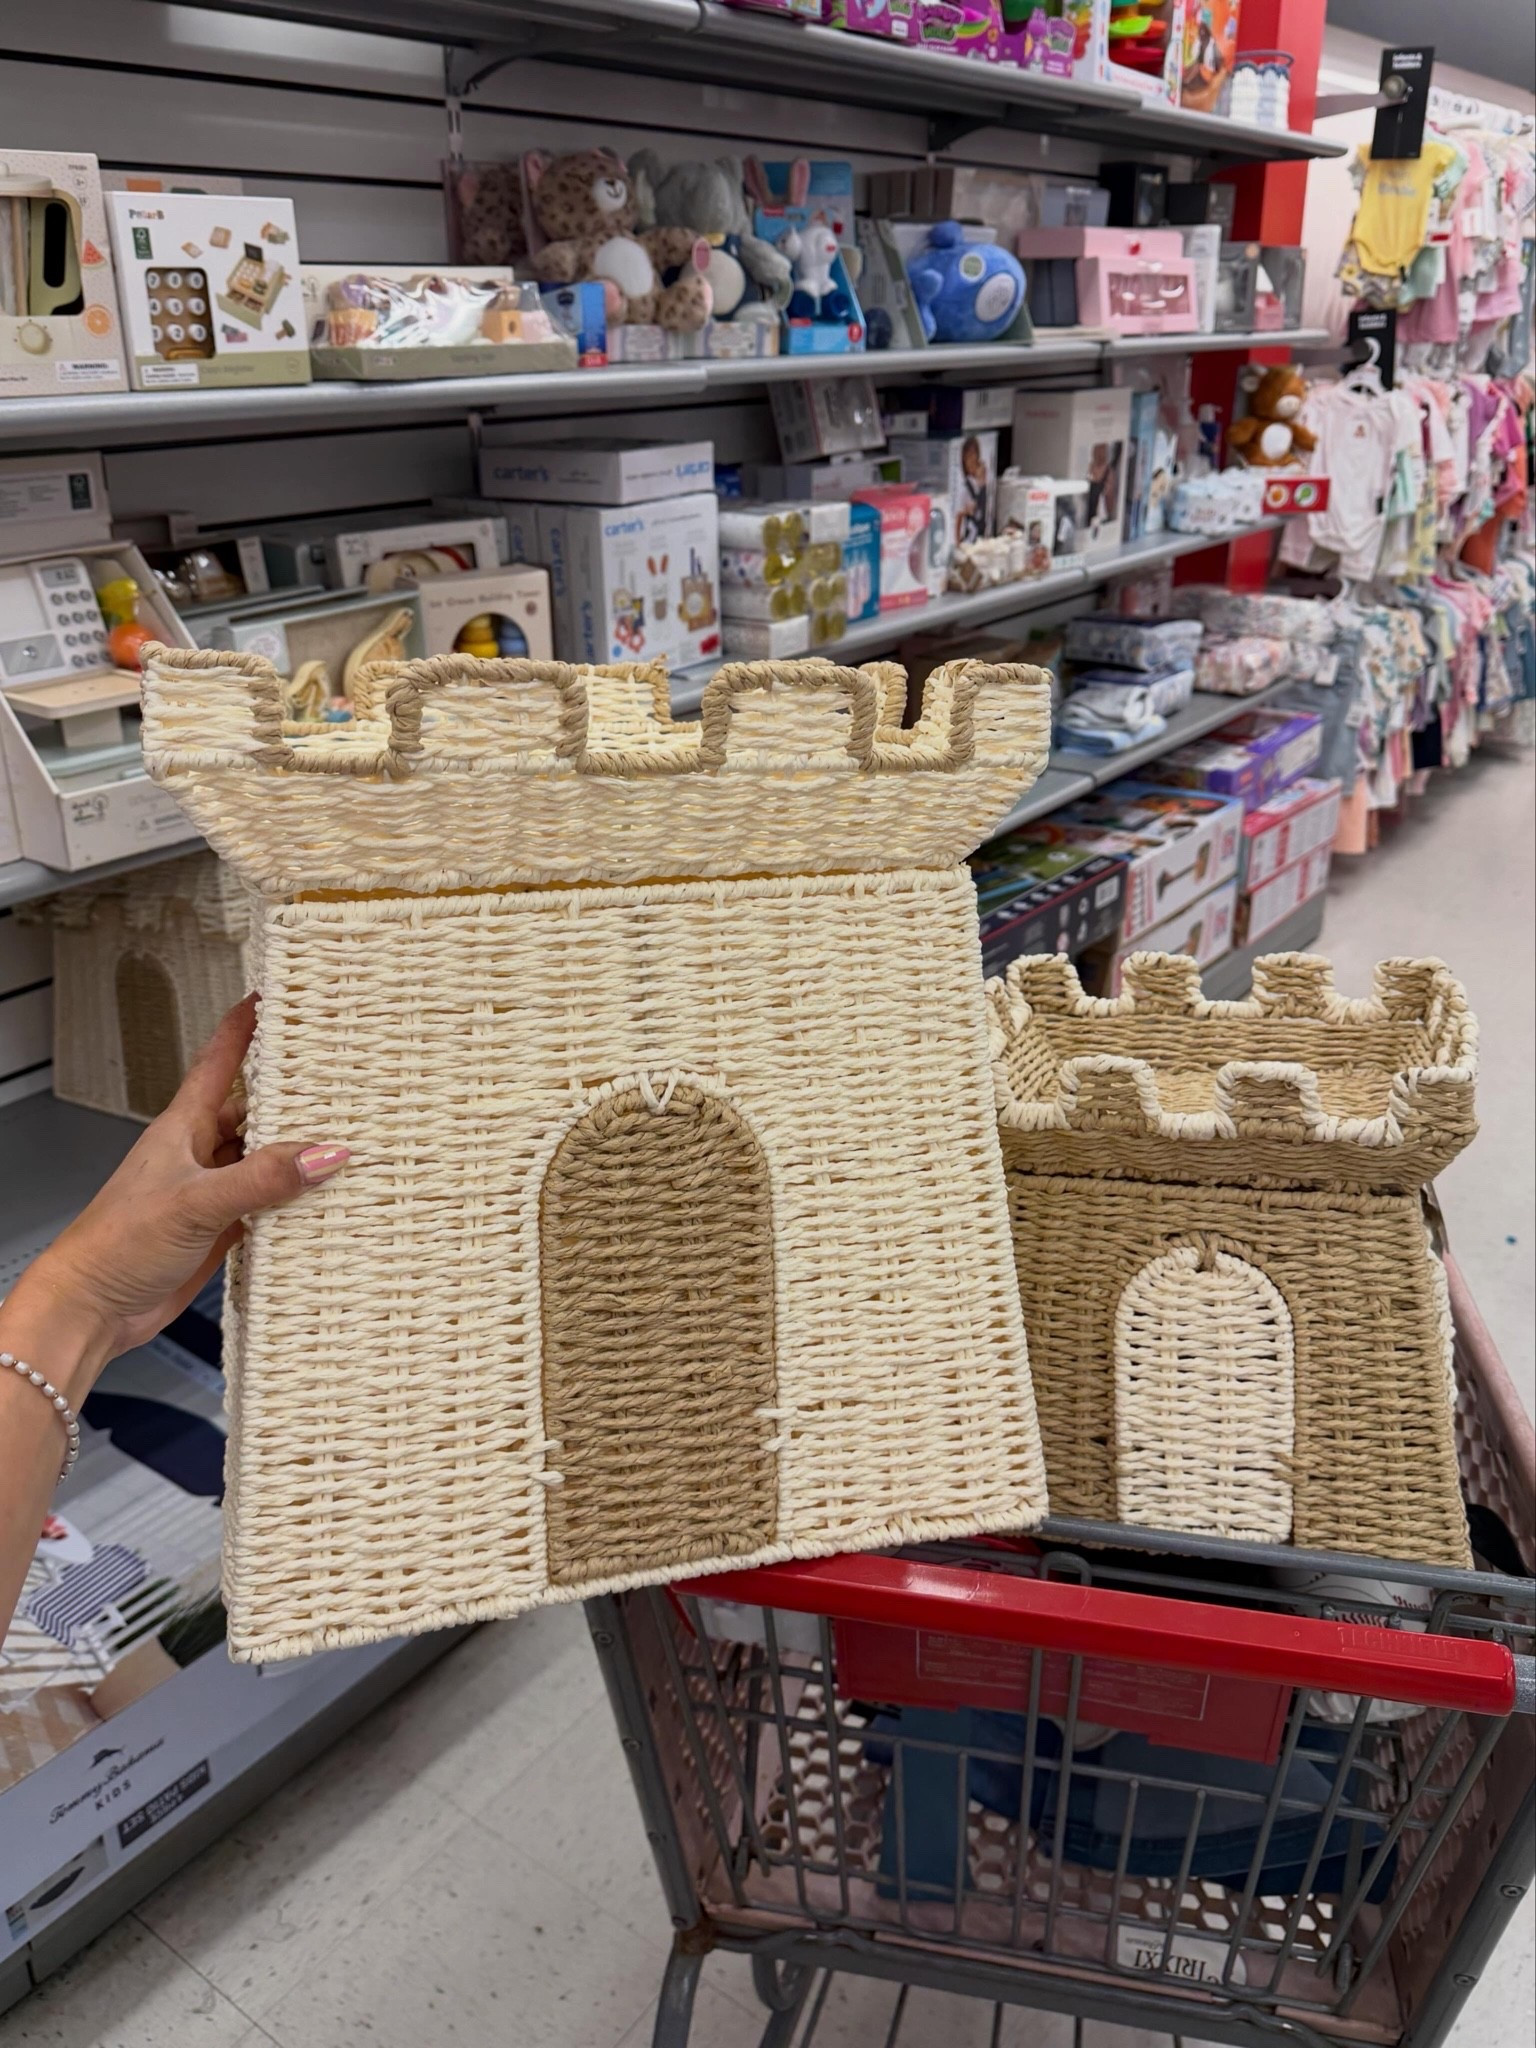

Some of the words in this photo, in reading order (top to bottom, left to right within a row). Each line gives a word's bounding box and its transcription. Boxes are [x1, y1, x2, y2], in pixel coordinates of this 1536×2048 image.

[493, 466, 549, 482] carter's
[605, 517, 645, 537] carter's
[95, 1779, 131, 1811] KIDS
[1134, 1949, 1206, 1984] TRIXI
